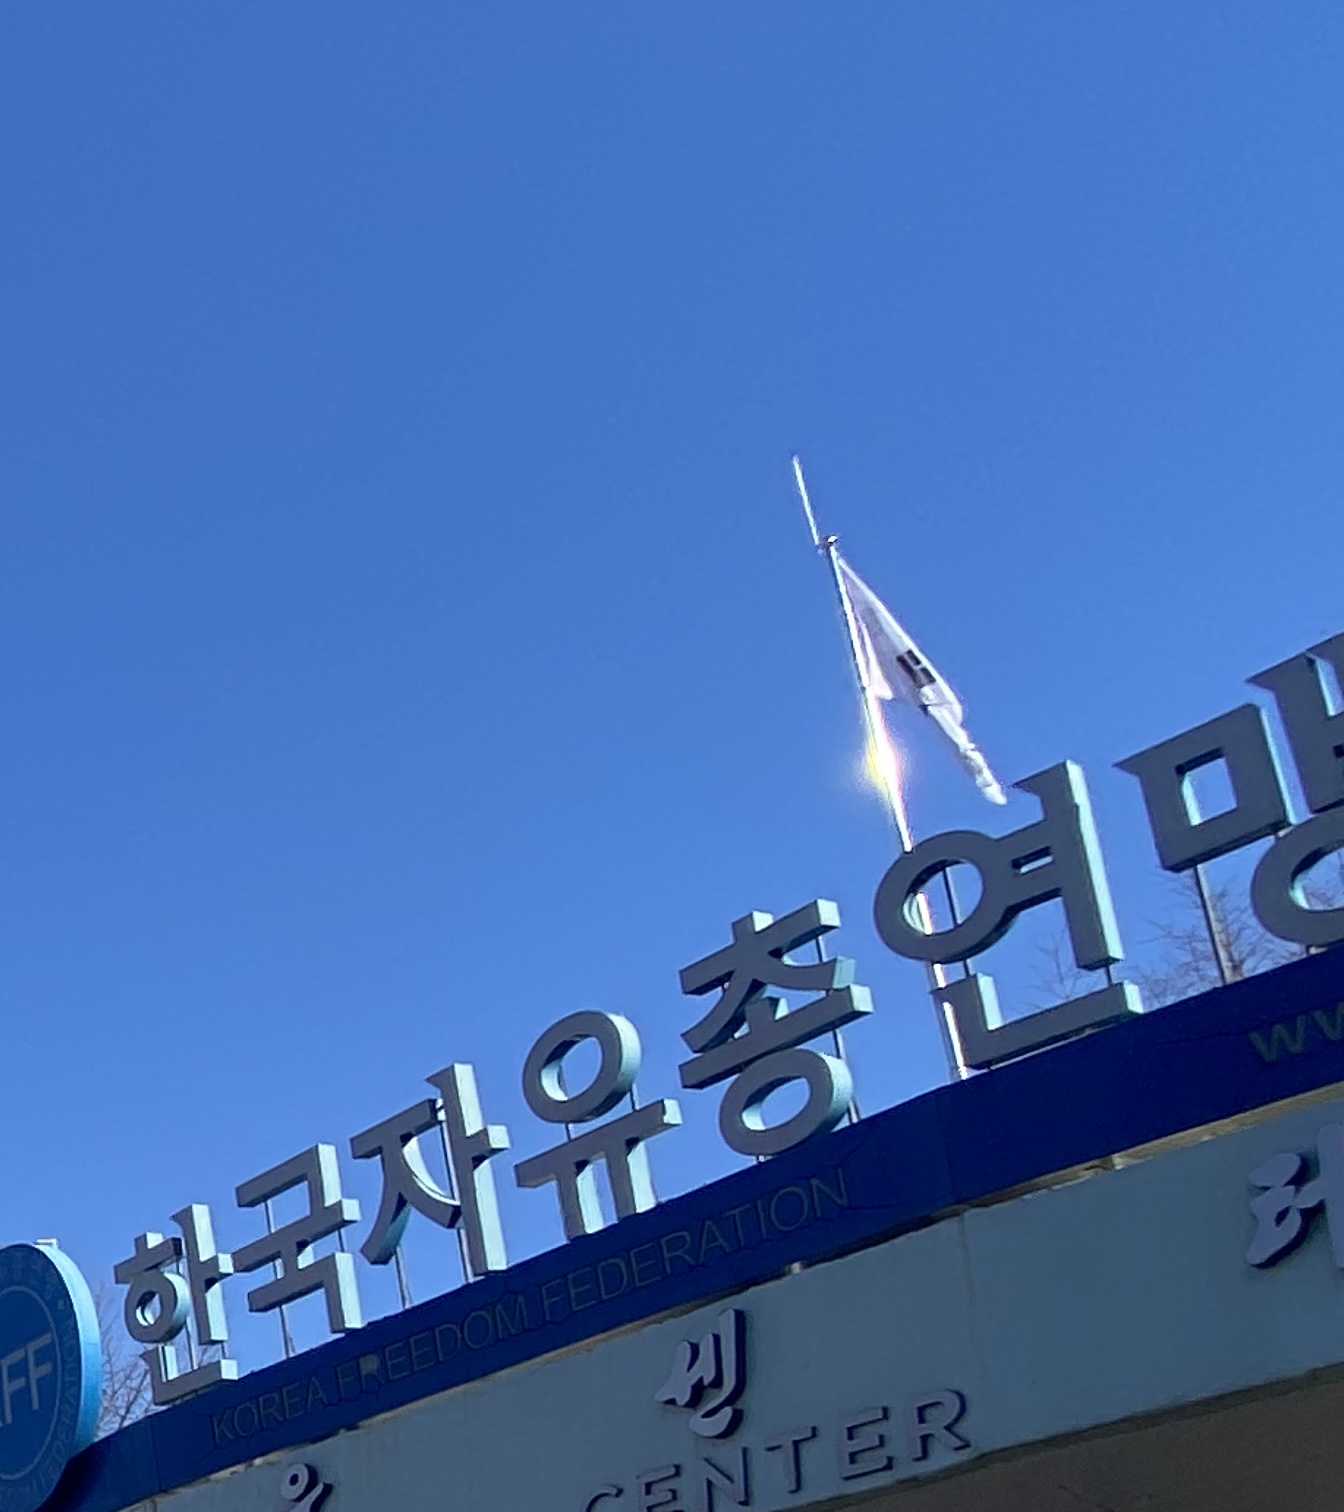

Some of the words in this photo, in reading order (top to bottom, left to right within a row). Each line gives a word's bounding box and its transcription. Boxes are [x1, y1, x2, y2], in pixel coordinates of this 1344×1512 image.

[114, 632, 1344, 1406] 한국자유총연맹
[212, 1376, 328, 1448] KOREA
[336, 1291, 530, 1392] FREEDOM
[542, 1164, 851, 1324] FEDERATION
